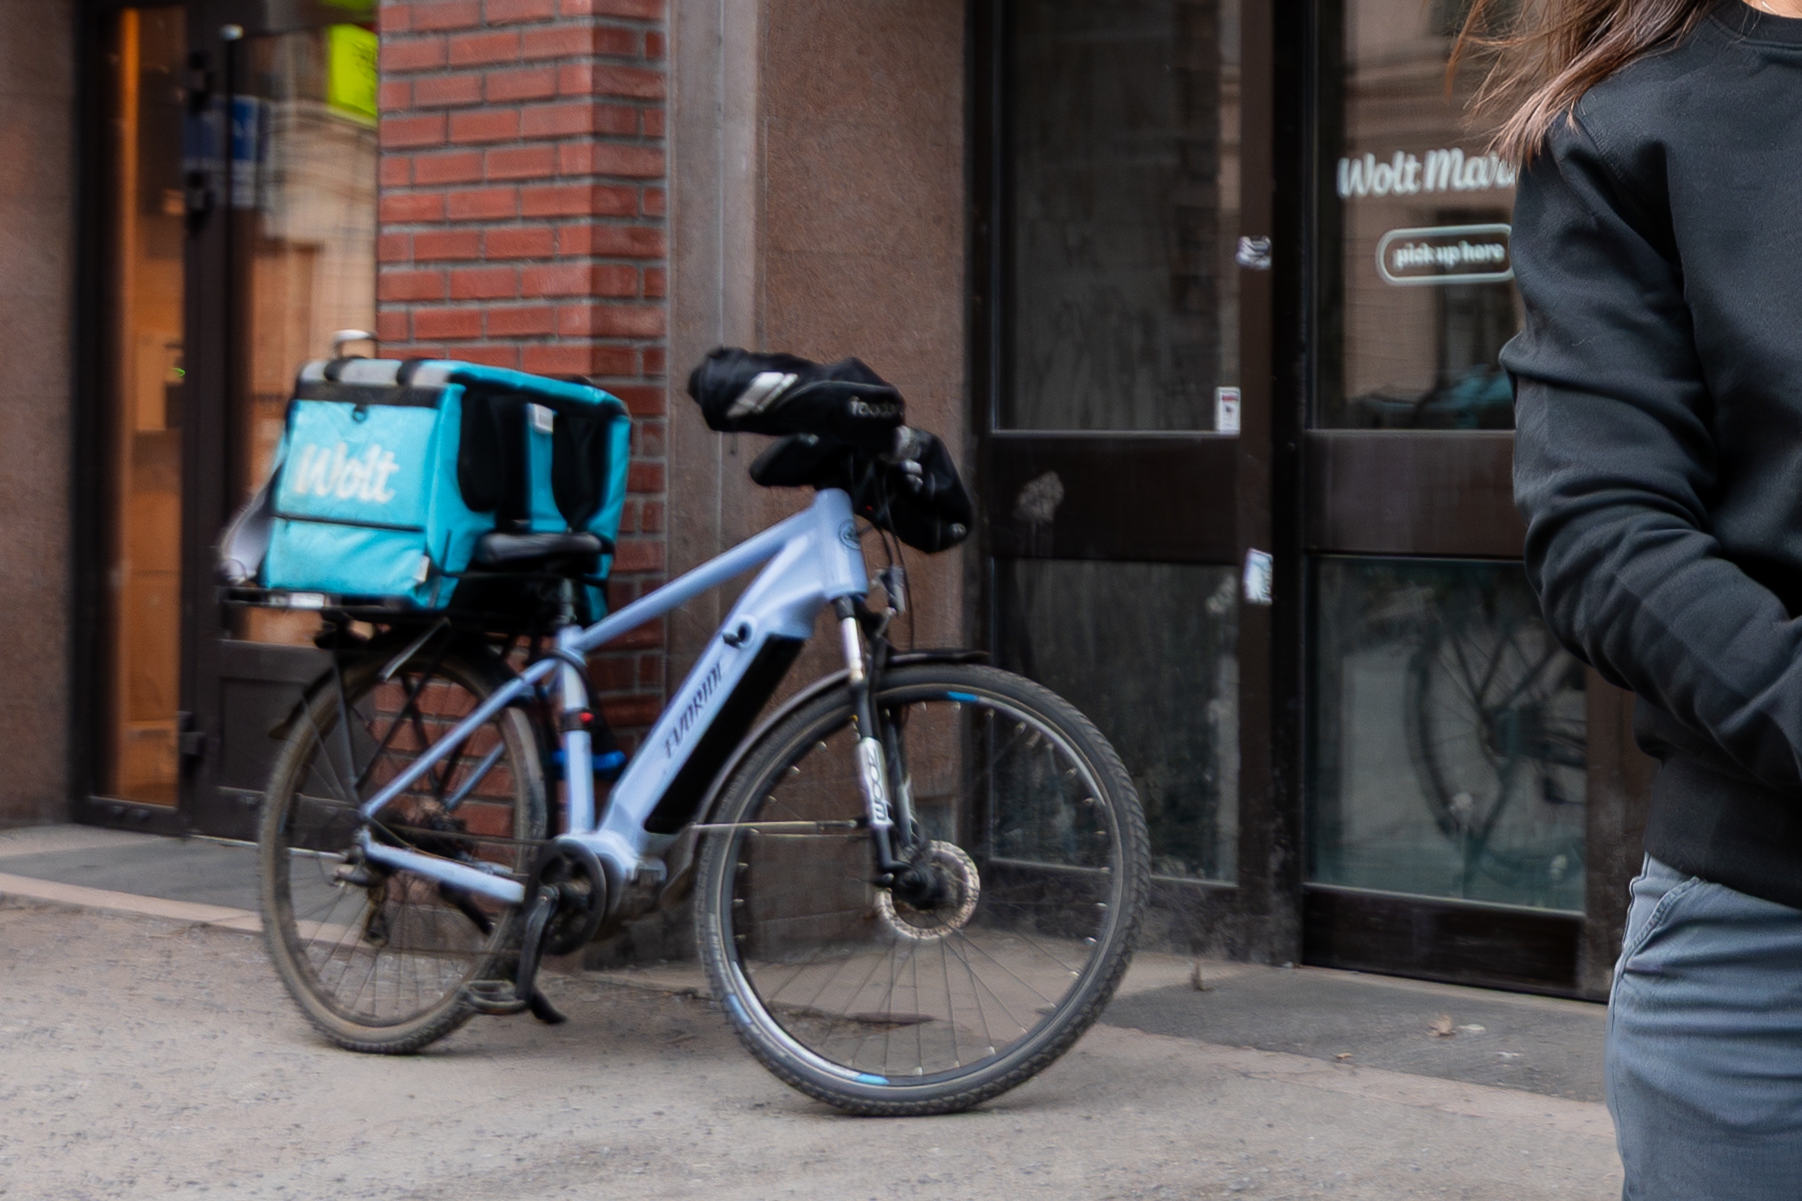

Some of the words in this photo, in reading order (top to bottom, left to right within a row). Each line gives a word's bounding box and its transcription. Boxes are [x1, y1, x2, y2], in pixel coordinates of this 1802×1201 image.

[1337, 152, 1421, 198] Wolt
[1424, 148, 1516, 192] Mar
[294, 441, 399, 504] Wolt
